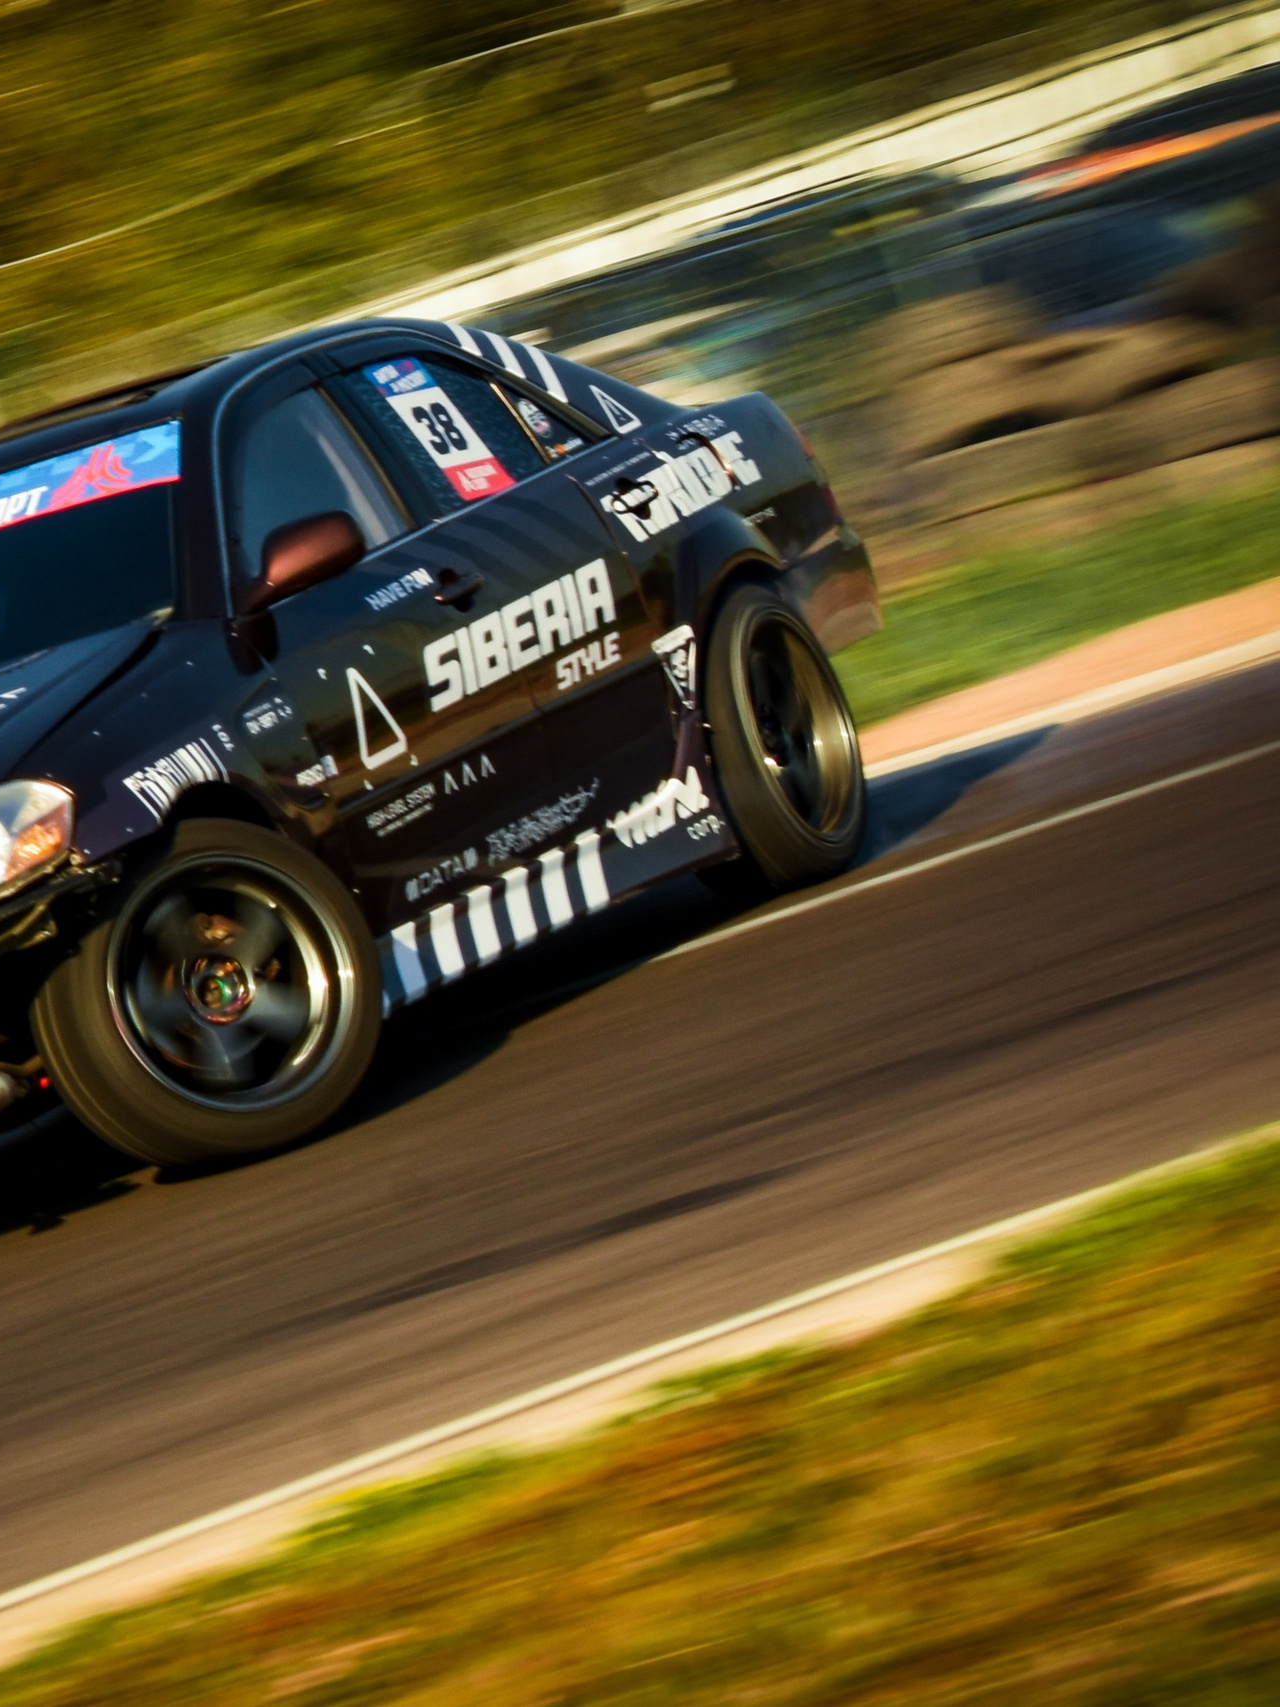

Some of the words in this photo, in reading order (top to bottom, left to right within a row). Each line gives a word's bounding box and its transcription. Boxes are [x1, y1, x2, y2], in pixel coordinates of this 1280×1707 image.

[410, 402, 469, 455] 38
[365, 581, 408, 611] HAVE
[423, 557, 617, 713] SIBERIA
[556, 631, 622, 692] STYLE
[686, 814, 726, 841] corp.
